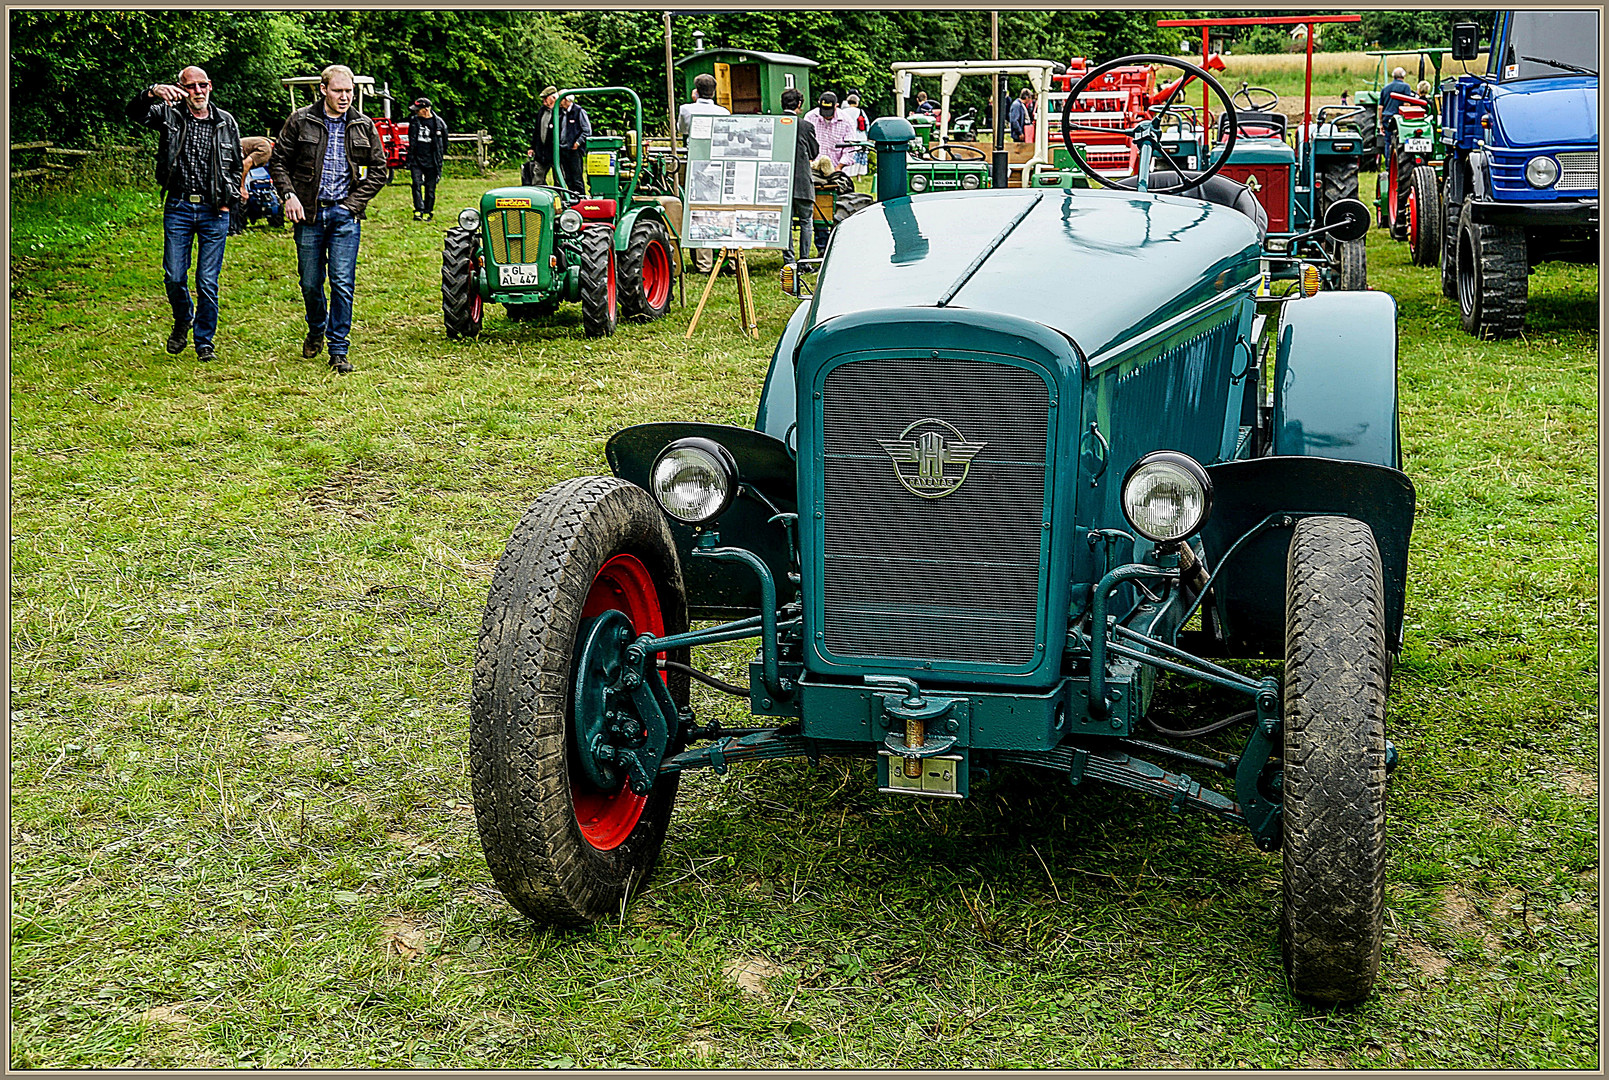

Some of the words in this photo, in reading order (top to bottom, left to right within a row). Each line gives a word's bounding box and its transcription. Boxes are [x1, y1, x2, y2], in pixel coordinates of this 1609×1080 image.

[511, 266, 525, 275] GL
[502, 275, 516, 285] AL
[519, 275, 537, 285] 447
